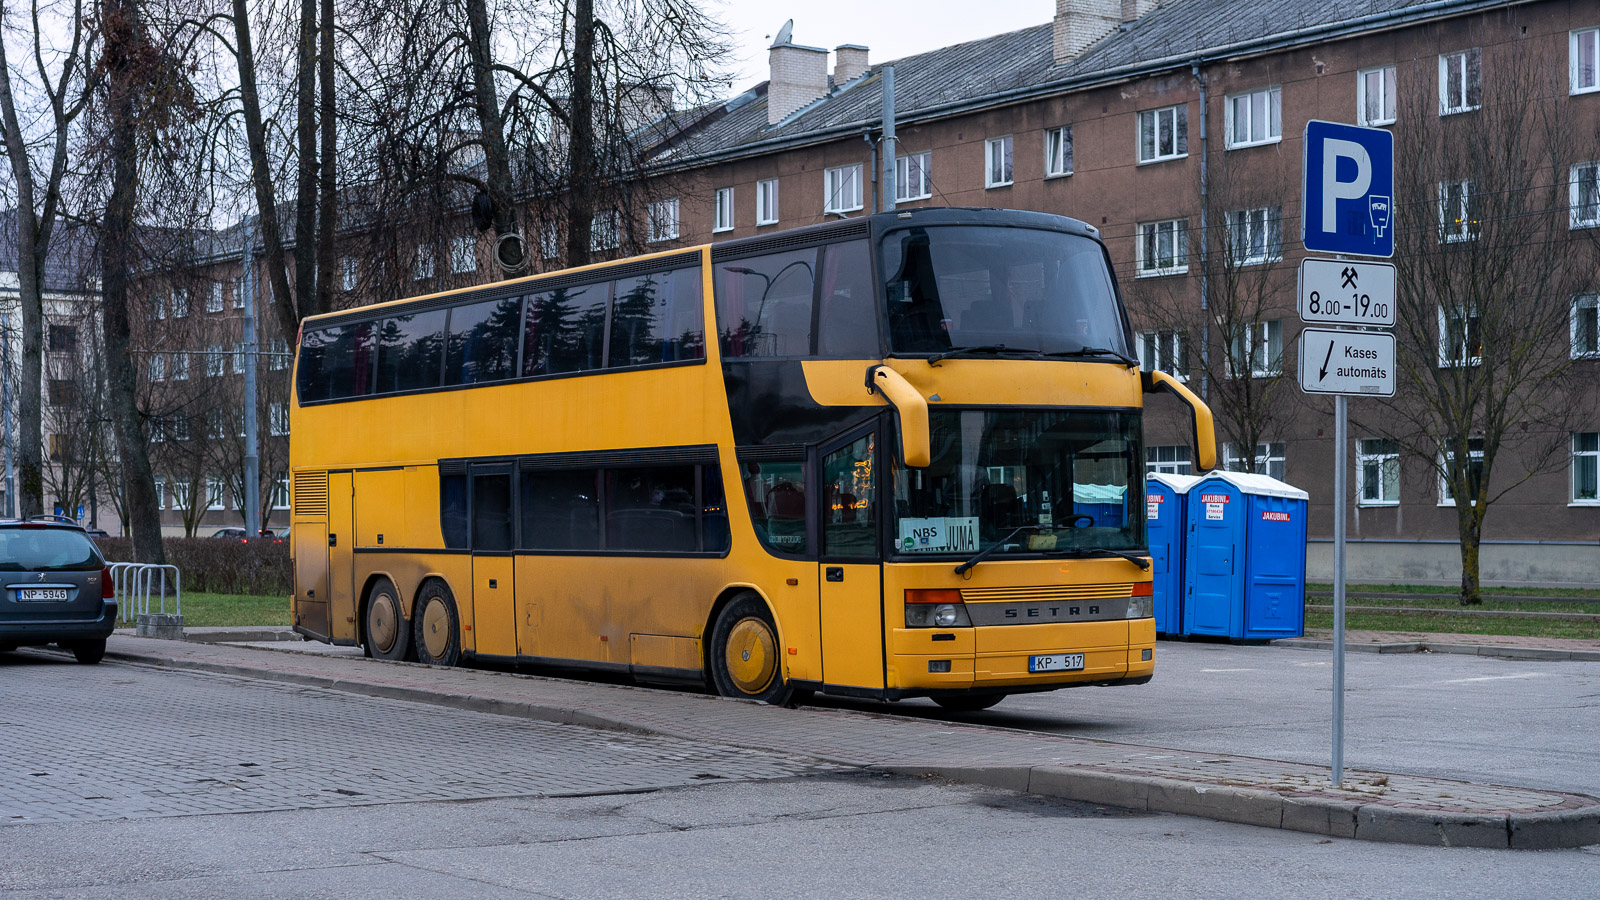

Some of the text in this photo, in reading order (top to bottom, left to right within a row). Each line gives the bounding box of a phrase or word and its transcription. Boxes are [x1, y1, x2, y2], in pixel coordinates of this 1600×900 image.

[1322, 137, 1372, 233] P
[1344, 345, 1378, 360] Kases
[1336, 366, 1387, 379] automāts
[913, 526, 938, 539] NBS
[23, 590, 66, 599] NP-5946
[1005, 605, 1100, 618] SETRA
